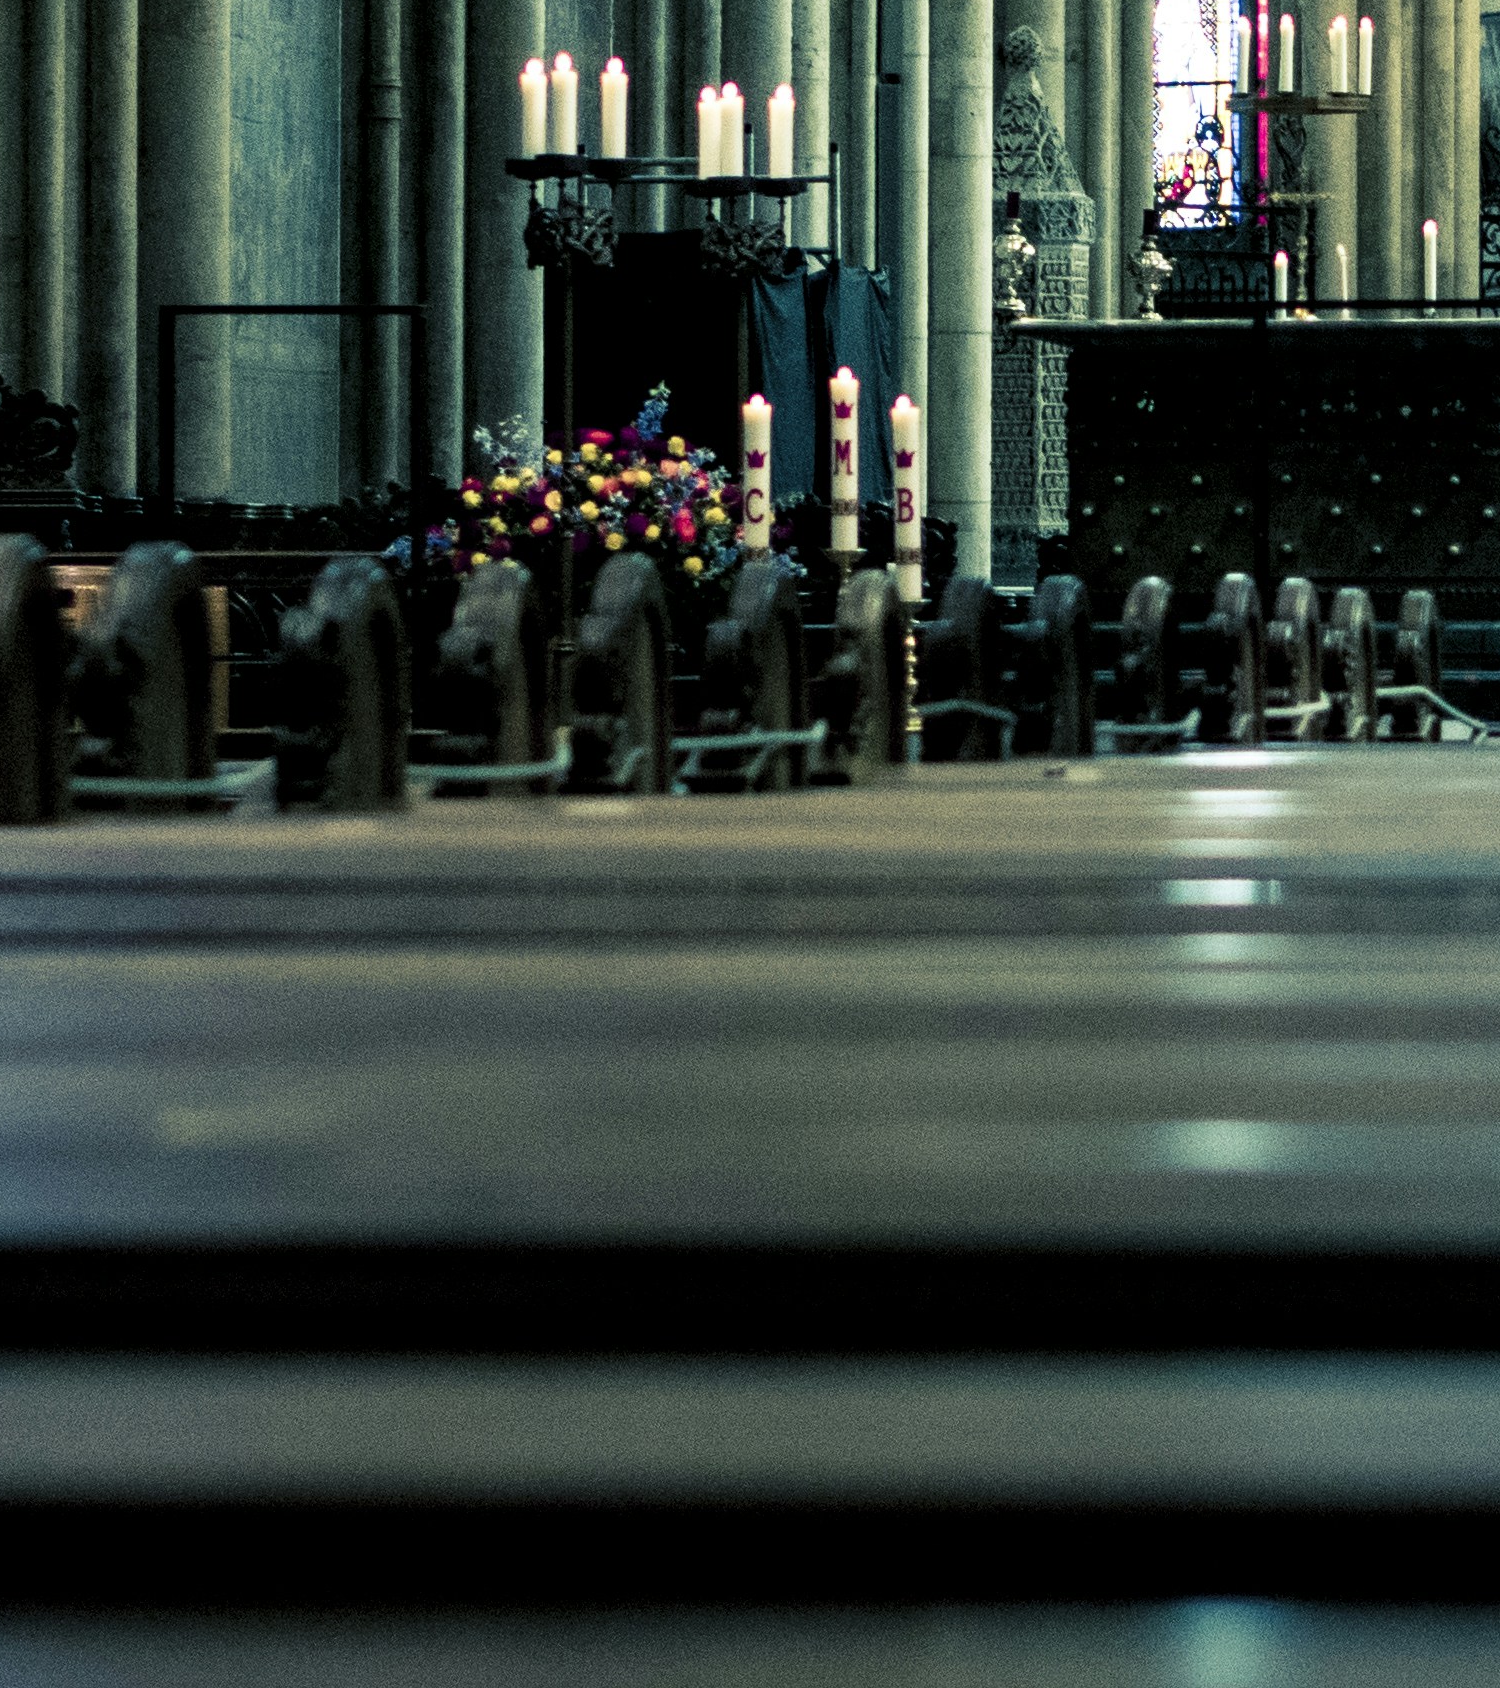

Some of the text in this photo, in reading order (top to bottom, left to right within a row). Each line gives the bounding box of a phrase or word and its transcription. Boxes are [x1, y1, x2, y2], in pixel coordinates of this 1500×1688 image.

[834, 439, 852, 475] M
[745, 488, 763, 523] C
[896, 488, 914, 523] B
